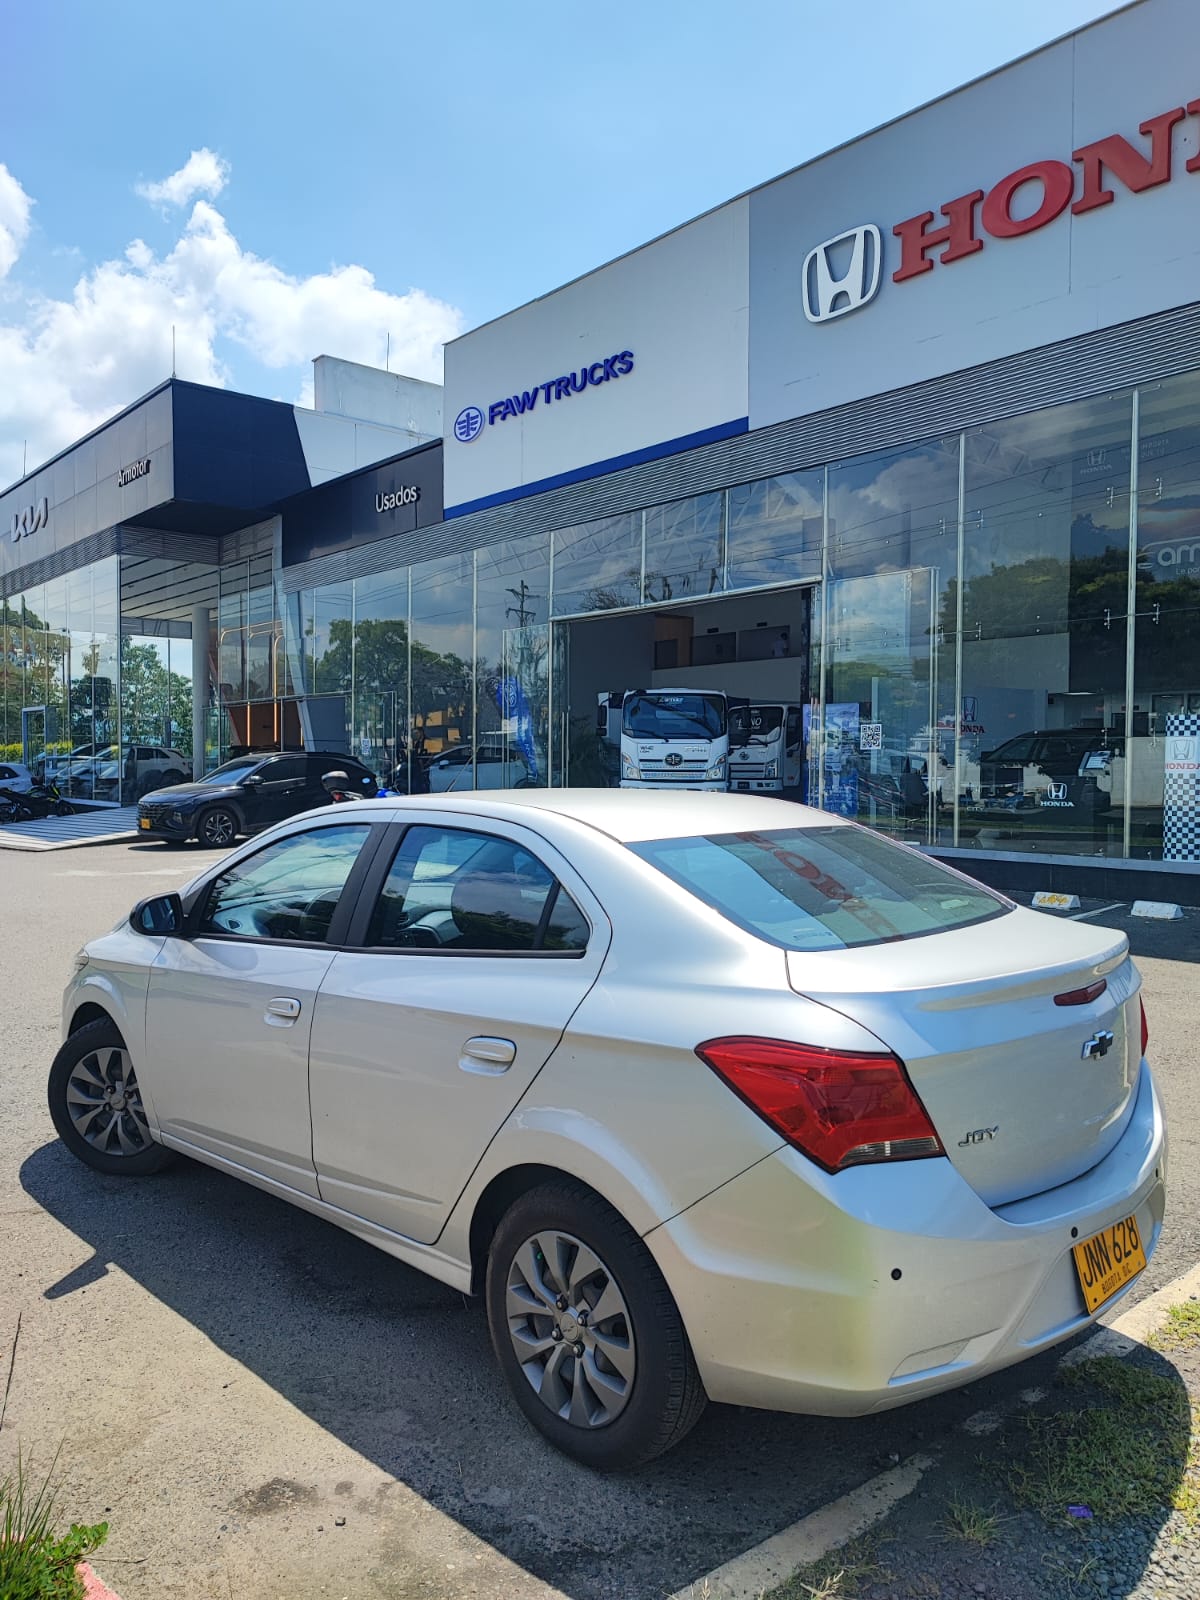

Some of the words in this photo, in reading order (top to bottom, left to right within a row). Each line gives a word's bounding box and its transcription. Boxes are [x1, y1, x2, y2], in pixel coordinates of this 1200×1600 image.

[892, 98, 1200, 283] HON
[488, 386, 540, 426] FAW
[540, 350, 634, 404] TRUCKS
[117, 459, 151, 487] Armotor
[375, 485, 419, 513] Usados
[10, 498, 48, 543] KIA
[953, 724, 985, 734] ONDA
[1040, 800, 1075, 808] HONDA
[958, 1125, 999, 1147] JOY
[1083, 1232, 1112, 1287] JNN
[1112, 1216, 1139, 1264] 628
